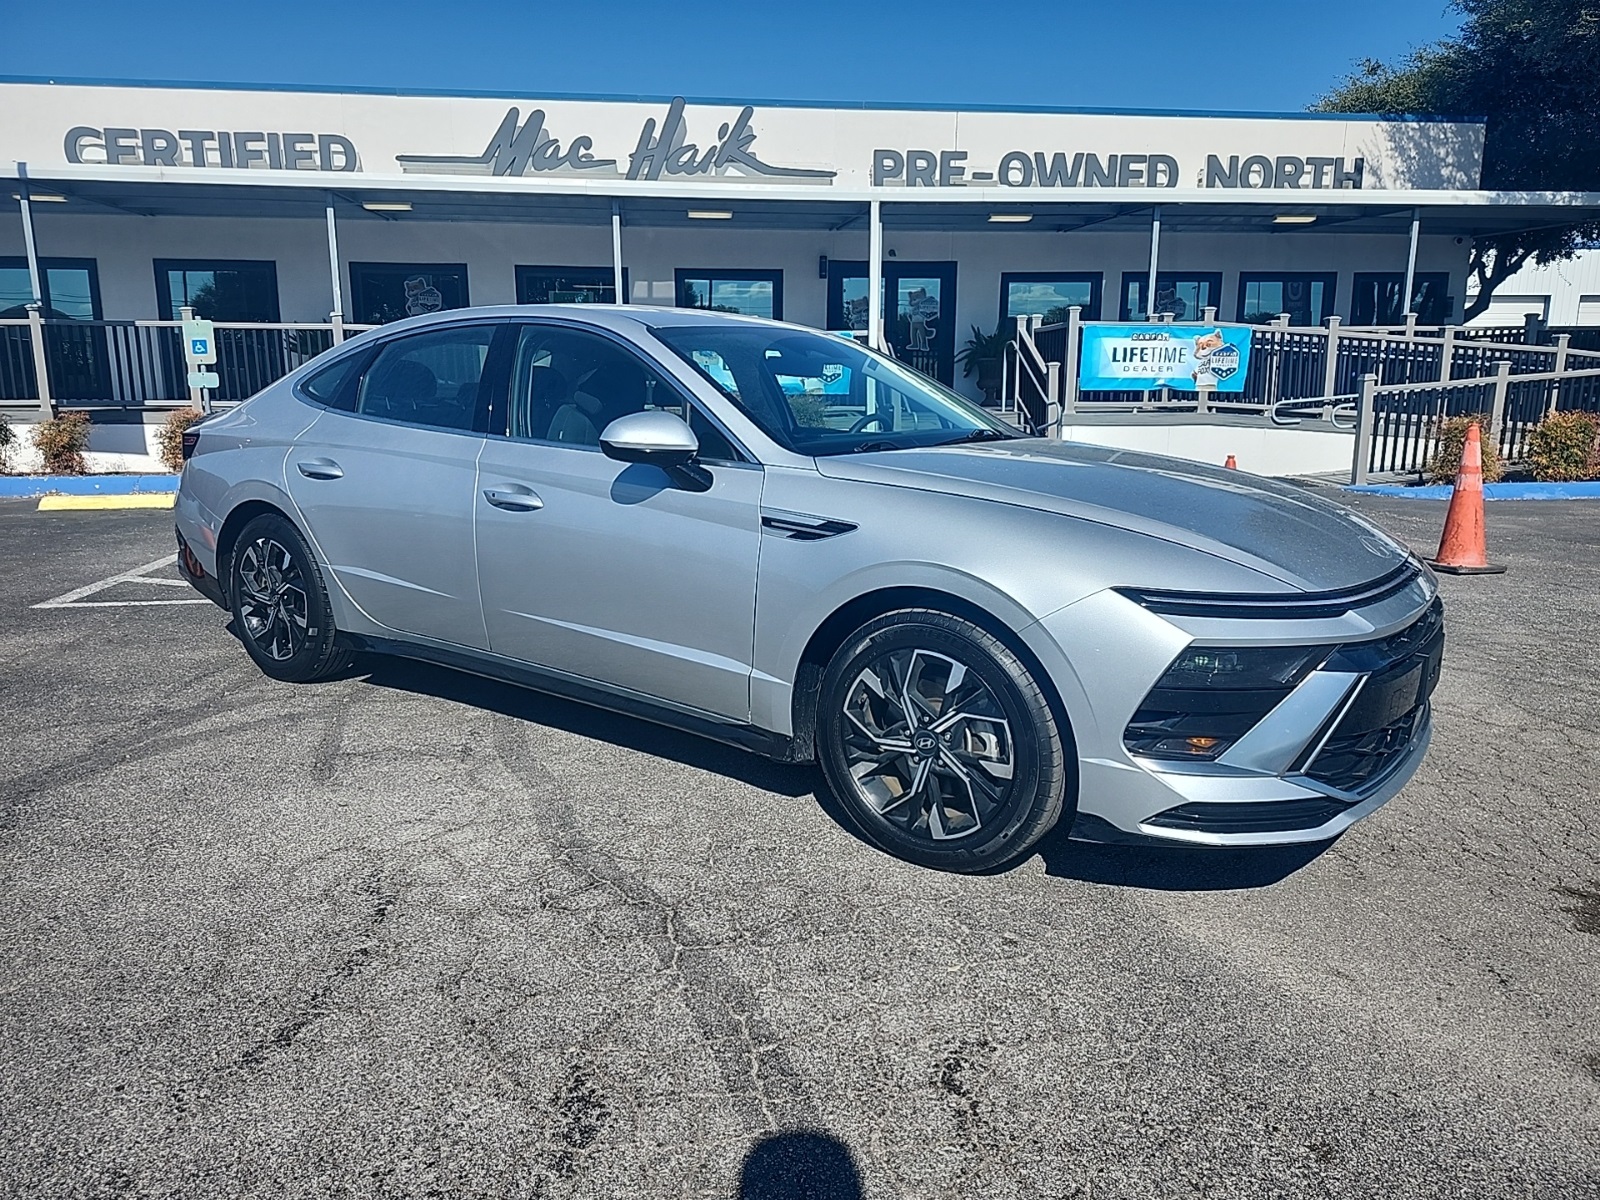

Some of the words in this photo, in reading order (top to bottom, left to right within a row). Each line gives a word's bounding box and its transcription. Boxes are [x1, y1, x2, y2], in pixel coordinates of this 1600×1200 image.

[64, 126, 360, 172] CERTIFIED
[396, 107, 616, 176] Mac
[625, 97, 837, 180] Haik
[872, 150, 1180, 188] PRE-OWNED
[1206, 154, 1365, 189] NORTH
[1112, 347, 1187, 363] LIFETIME
[1131, 333, 1169, 341] CARFAX
